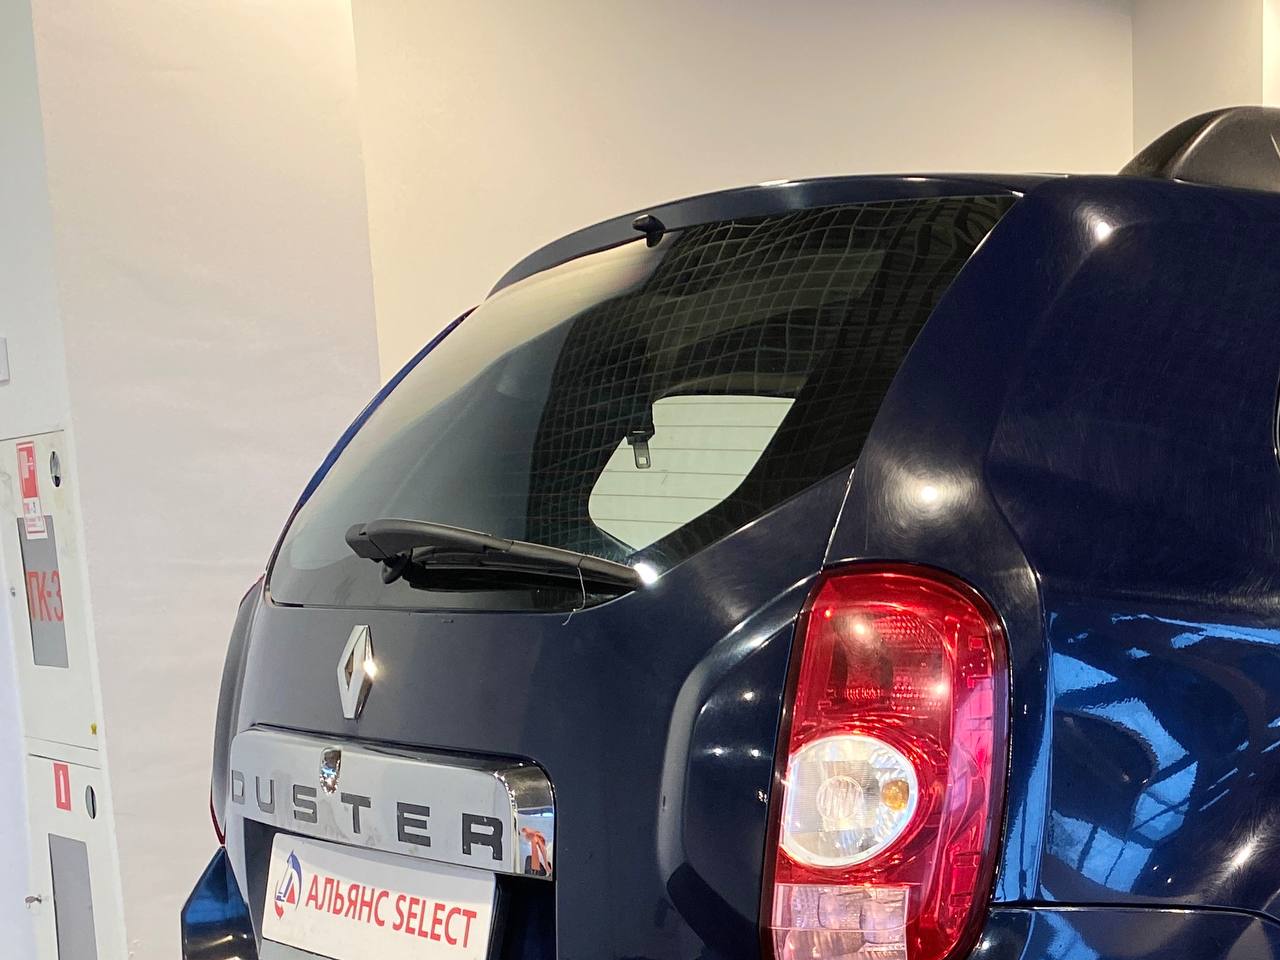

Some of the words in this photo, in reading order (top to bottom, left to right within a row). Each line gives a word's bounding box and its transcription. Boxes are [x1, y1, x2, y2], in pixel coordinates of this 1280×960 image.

[27, 570, 64, 622] ПК-3
[230, 769, 504, 861] DUSTER
[305, 874, 389, 927] АЛЬЯНС
[392, 894, 477, 948] SELECT
